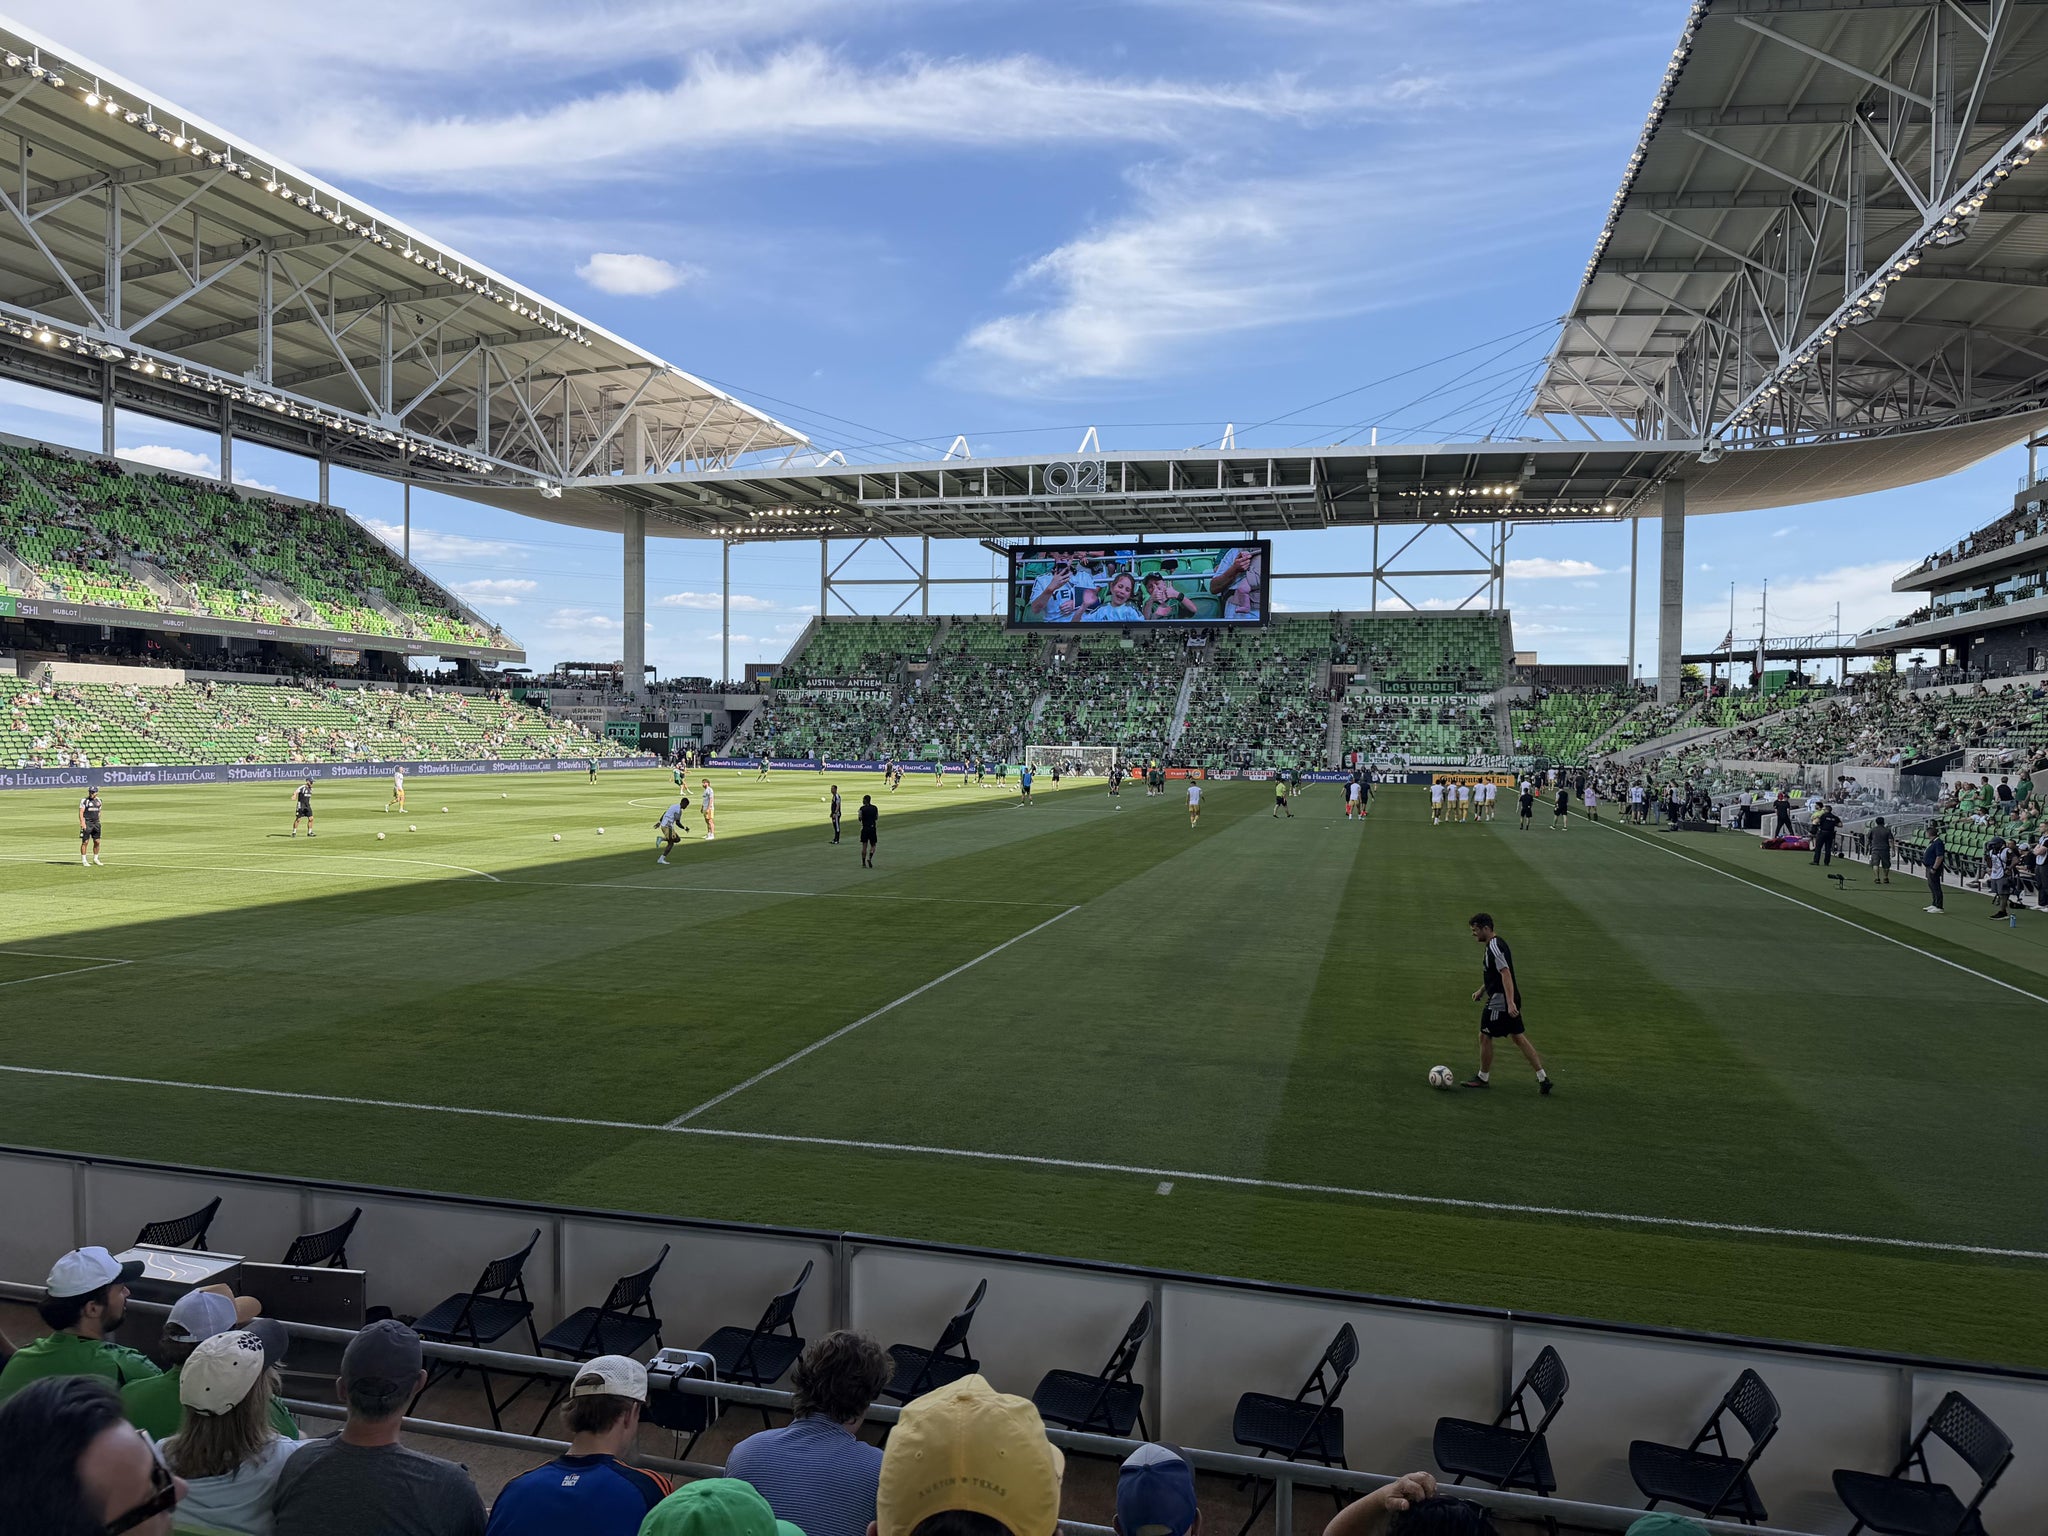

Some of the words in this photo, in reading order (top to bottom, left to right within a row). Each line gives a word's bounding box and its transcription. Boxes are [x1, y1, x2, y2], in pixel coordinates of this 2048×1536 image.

[1043, 460, 1099, 494] Q2
[53, 608, 77, 616] HUBLOT
[163, 619, 184, 627] HUBLOT
[806, 679, 835, 687] AUSTIN
[847, 679, 881, 687] ANTHEM
[1385, 683, 1406, 692] LOS
[1409, 683, 1454, 692] VERDES
[526, 690, 549, 699] AUSTIN
[1412, 695, 1428, 705] DE
[1431, 695, 1479, 705] AUSTIN
[670, 725, 690, 733] JABIL
[16, 772, 88, 785] HEALTHCARE
[158, 769, 216, 782] HEALTHCARE
[1378, 774, 1408, 784] YETI
